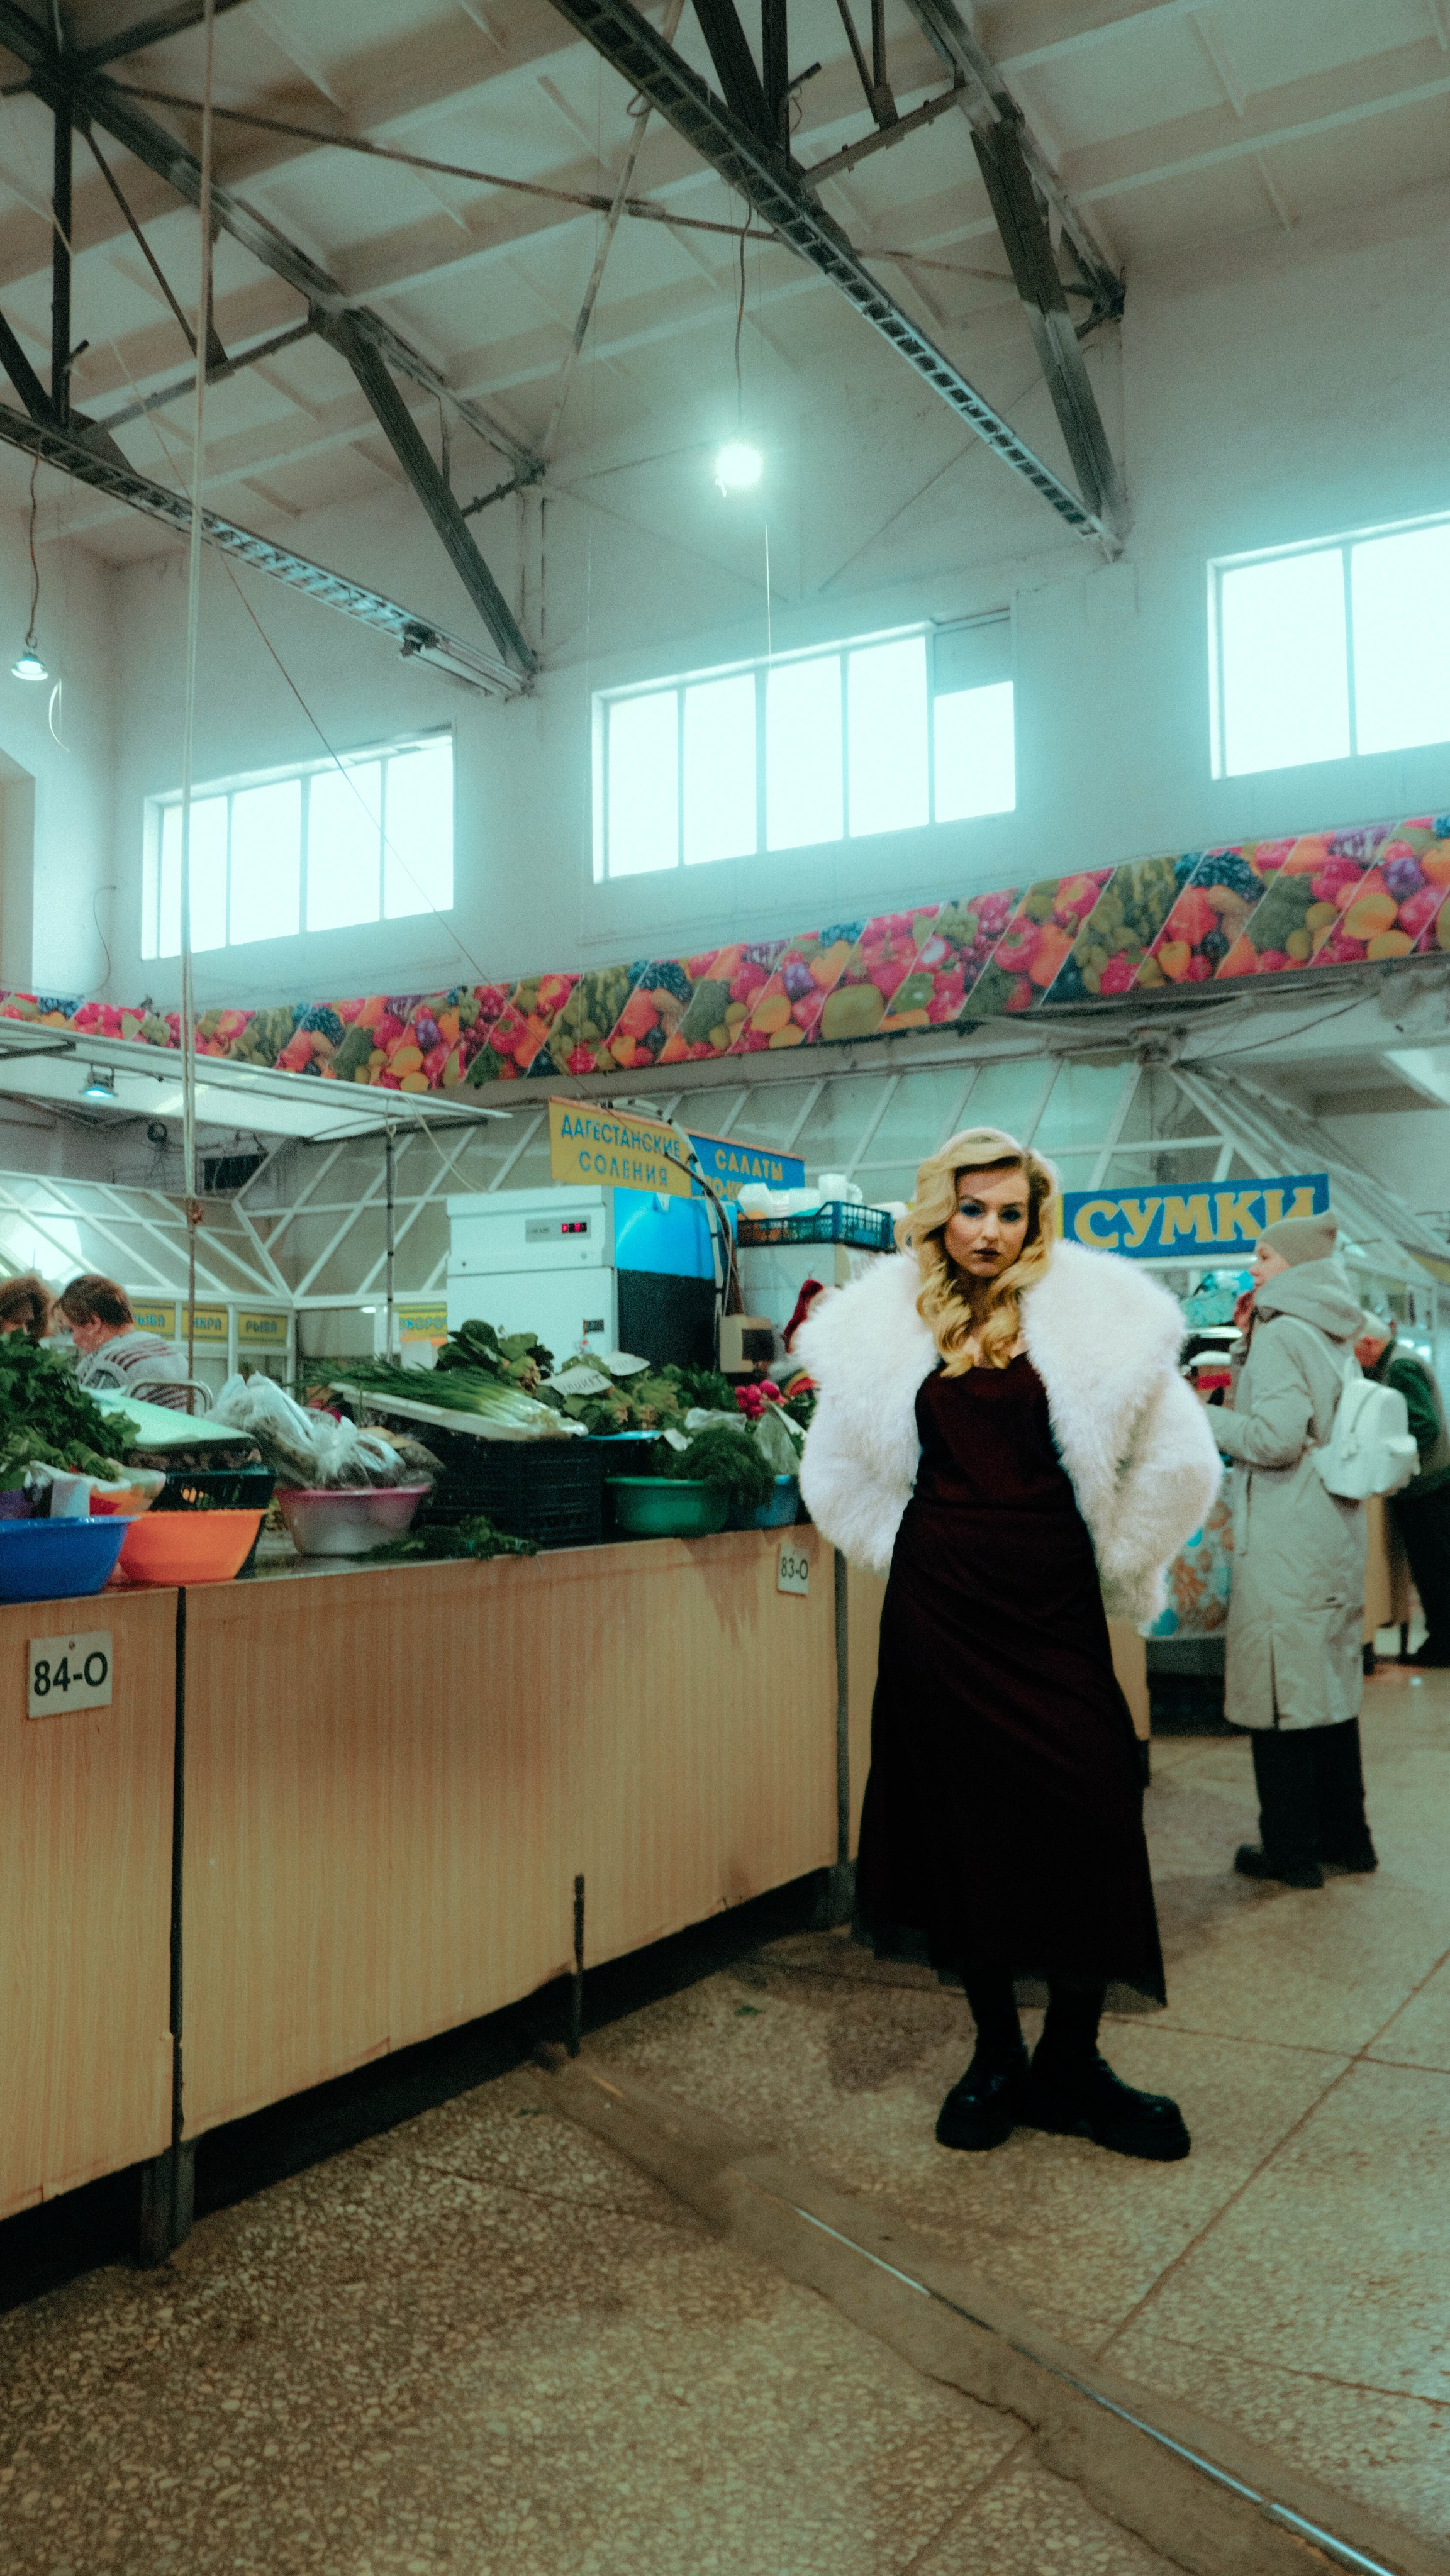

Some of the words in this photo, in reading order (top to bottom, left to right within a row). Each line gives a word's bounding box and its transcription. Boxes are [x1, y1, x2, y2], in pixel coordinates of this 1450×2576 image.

[561, 1114, 681, 1159] ДАГЕСТАНСКИЕ
[579, 1150, 669, 1186] СОЛЕНИЯ
[715, 1148, 783, 1182] САЛАТЫ
[1074, 1186, 1316, 1249] СУМКИ
